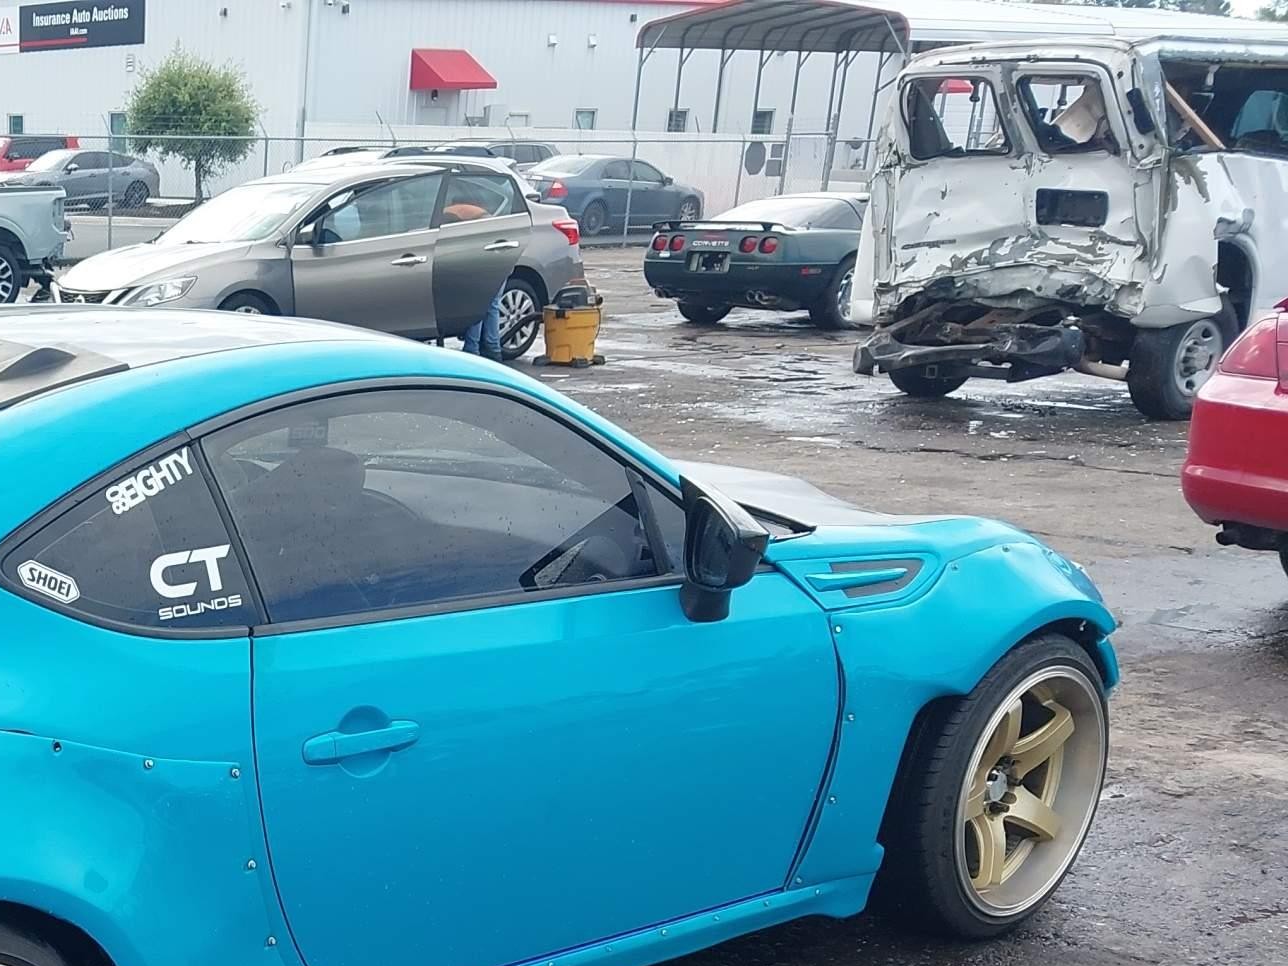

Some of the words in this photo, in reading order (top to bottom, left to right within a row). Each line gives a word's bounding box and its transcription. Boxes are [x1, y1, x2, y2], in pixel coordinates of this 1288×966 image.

[33, 11, 70, 27] Insurance
[72, 8, 90, 24] Auto
[92, 5, 128, 22] Auctions
[27, 566, 72, 598] SHOEI
[150, 544, 230, 598] CT
[159, 594, 242, 620] SOUNDS
